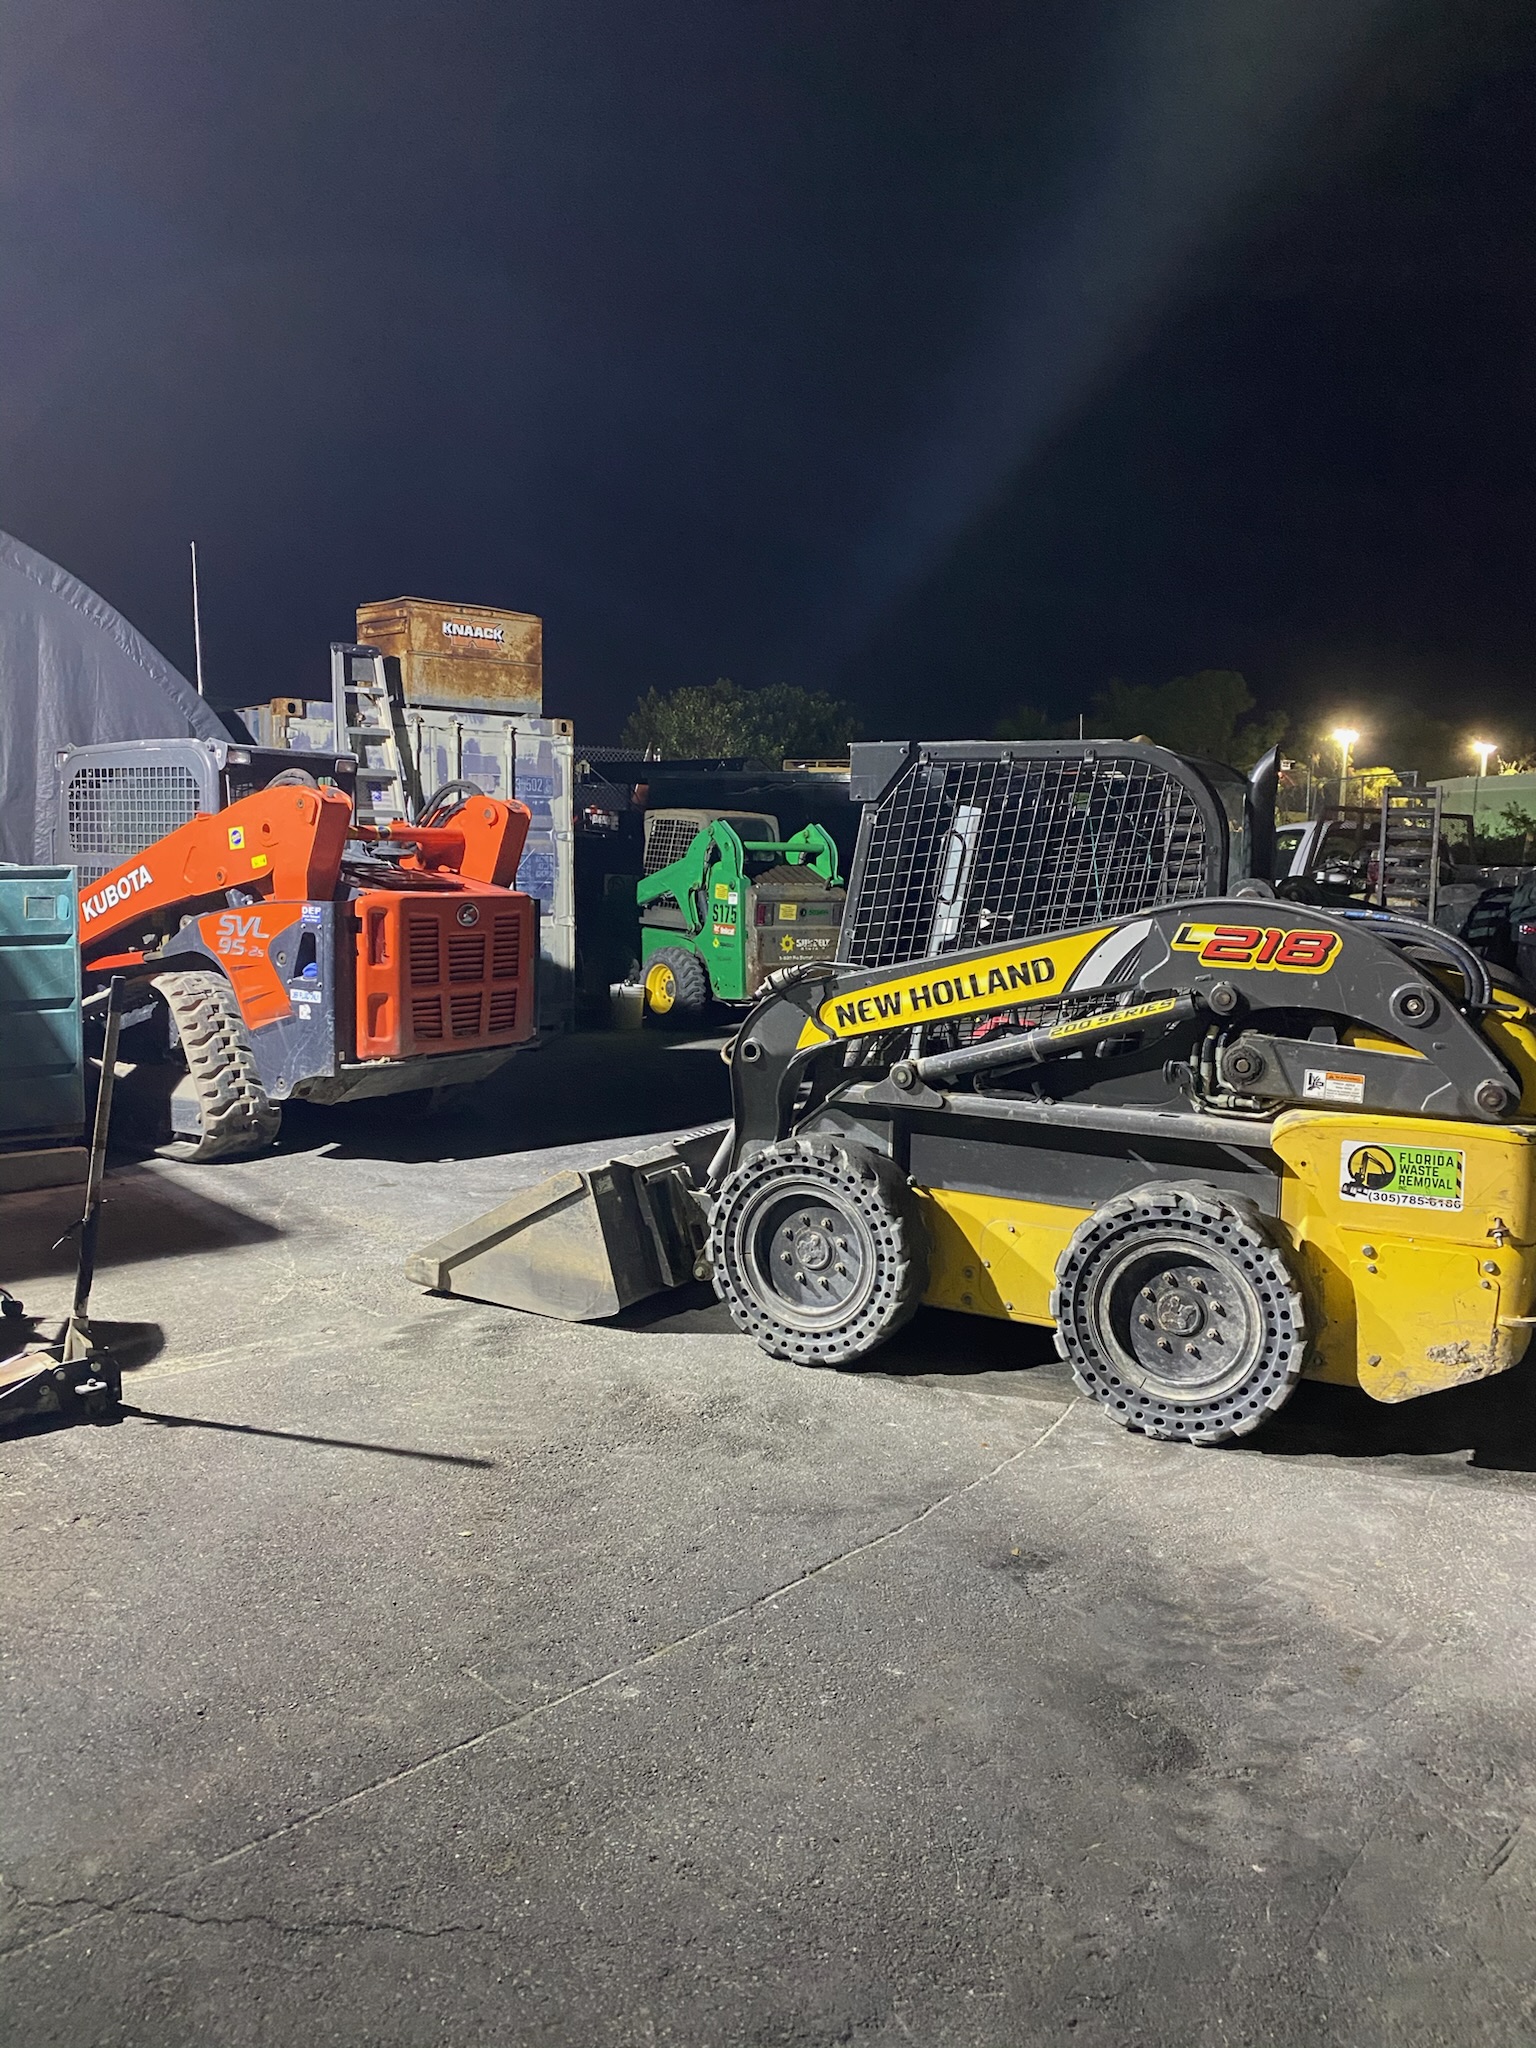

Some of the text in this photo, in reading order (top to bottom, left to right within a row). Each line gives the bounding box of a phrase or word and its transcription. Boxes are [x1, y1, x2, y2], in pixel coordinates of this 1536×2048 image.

[442, 621, 504, 643] KNAACK
[81, 864, 154, 923] KUBOTA
[712, 904, 737, 924] S175
[216, 914, 270, 939] SVL
[1175, 924, 1337, 968] L218
[834, 955, 1056, 1029] NEW HOLLAND
[1050, 999, 1174, 1036] 200 SERIES
[1399, 1152, 1454, 1168] FLORIDA
[1399, 1164, 1439, 1177] WASTE
[1398, 1175, 1453, 1190] REMOVAL
